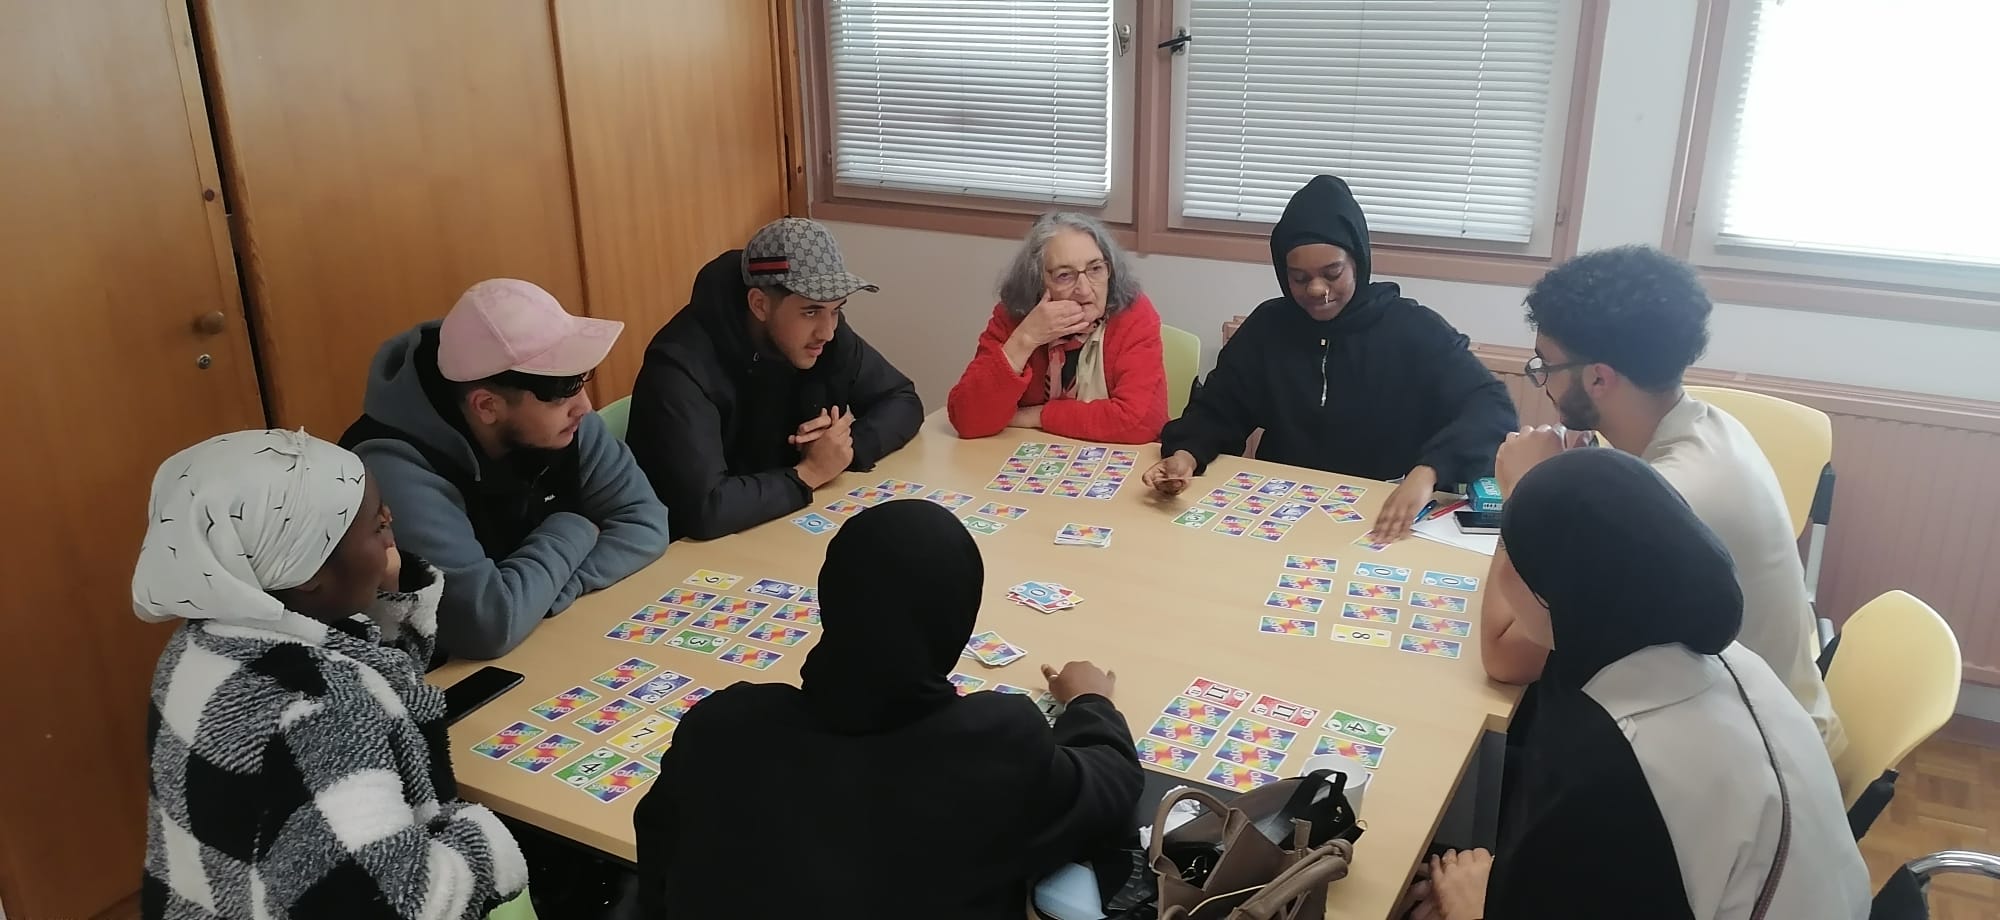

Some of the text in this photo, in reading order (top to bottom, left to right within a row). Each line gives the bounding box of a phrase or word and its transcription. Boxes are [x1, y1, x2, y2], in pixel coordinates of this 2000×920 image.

[1351, 631, 1371, 640] 8
[631, 727, 656, 739] 7
[1345, 722, 1368, 733] 4
[581, 763, 602, 774] 4
